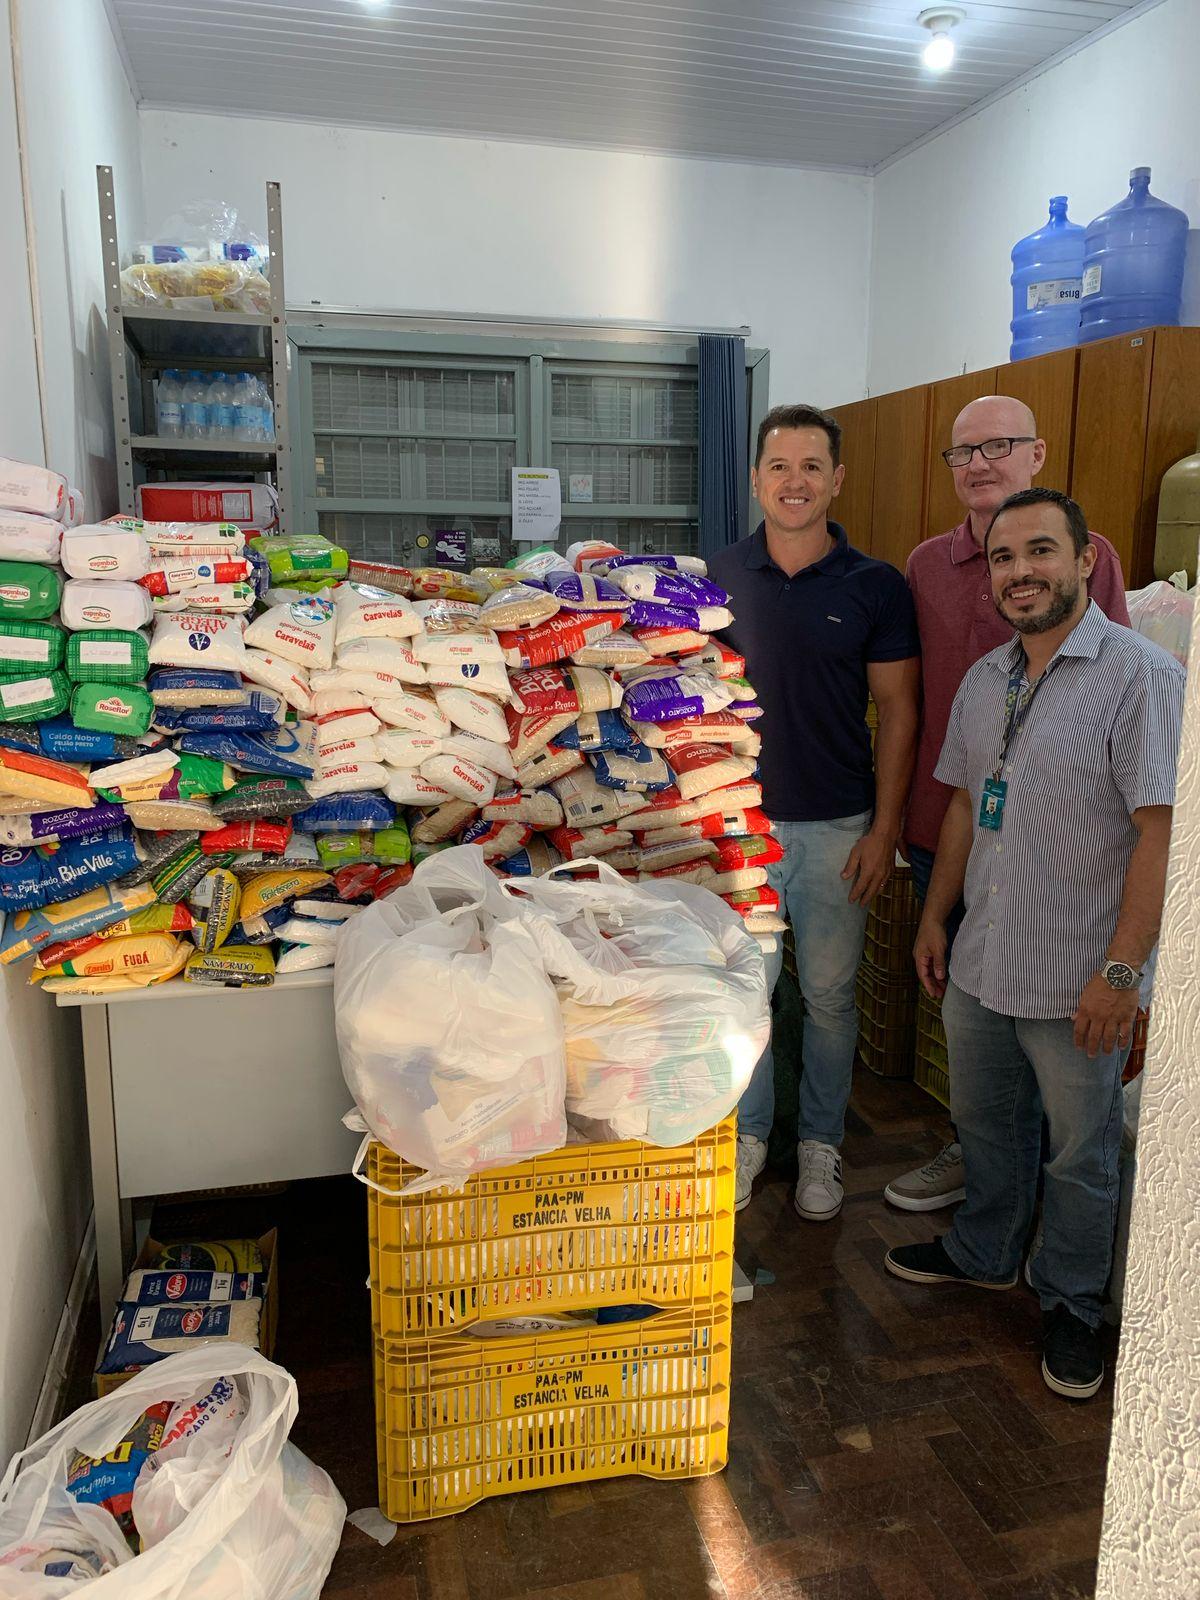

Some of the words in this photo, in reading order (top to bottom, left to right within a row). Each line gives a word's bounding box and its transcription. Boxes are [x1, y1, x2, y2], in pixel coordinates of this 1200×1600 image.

[1059, 290, 1080, 299] Brisa
[363, 609, 403, 622] Caravelas
[274, 629, 317, 652] Caravelas
[376, 671, 395, 684] ALTO
[99, 703, 131, 715] Roseflor
[667, 706, 697, 717] ROZCATO
[48, 732, 79, 741] Caldo
[79, 734, 101, 742] Nobre
[452, 765, 487, 792] Caravelas
[41, 810, 79, 825] ROZCATO
[57, 854, 114, 882] BlueVille
[219, 882, 234, 932] NAMORADO
[123, 951, 150, 967] FUBÁ
[202, 959, 256, 972] NAMORADO
[534, 1191, 584, 1208] PAA-PM
[512, 1211, 568, 1229] ESTANCIA
[574, 1207, 611, 1222] VELHA
[535, 1370, 583, 1387] PAA-PM
[513, 1390, 568, 1409] ESTANCIA
[573, 1385, 610, 1400] VELHA
[147, 1423, 165, 1451] Dica
